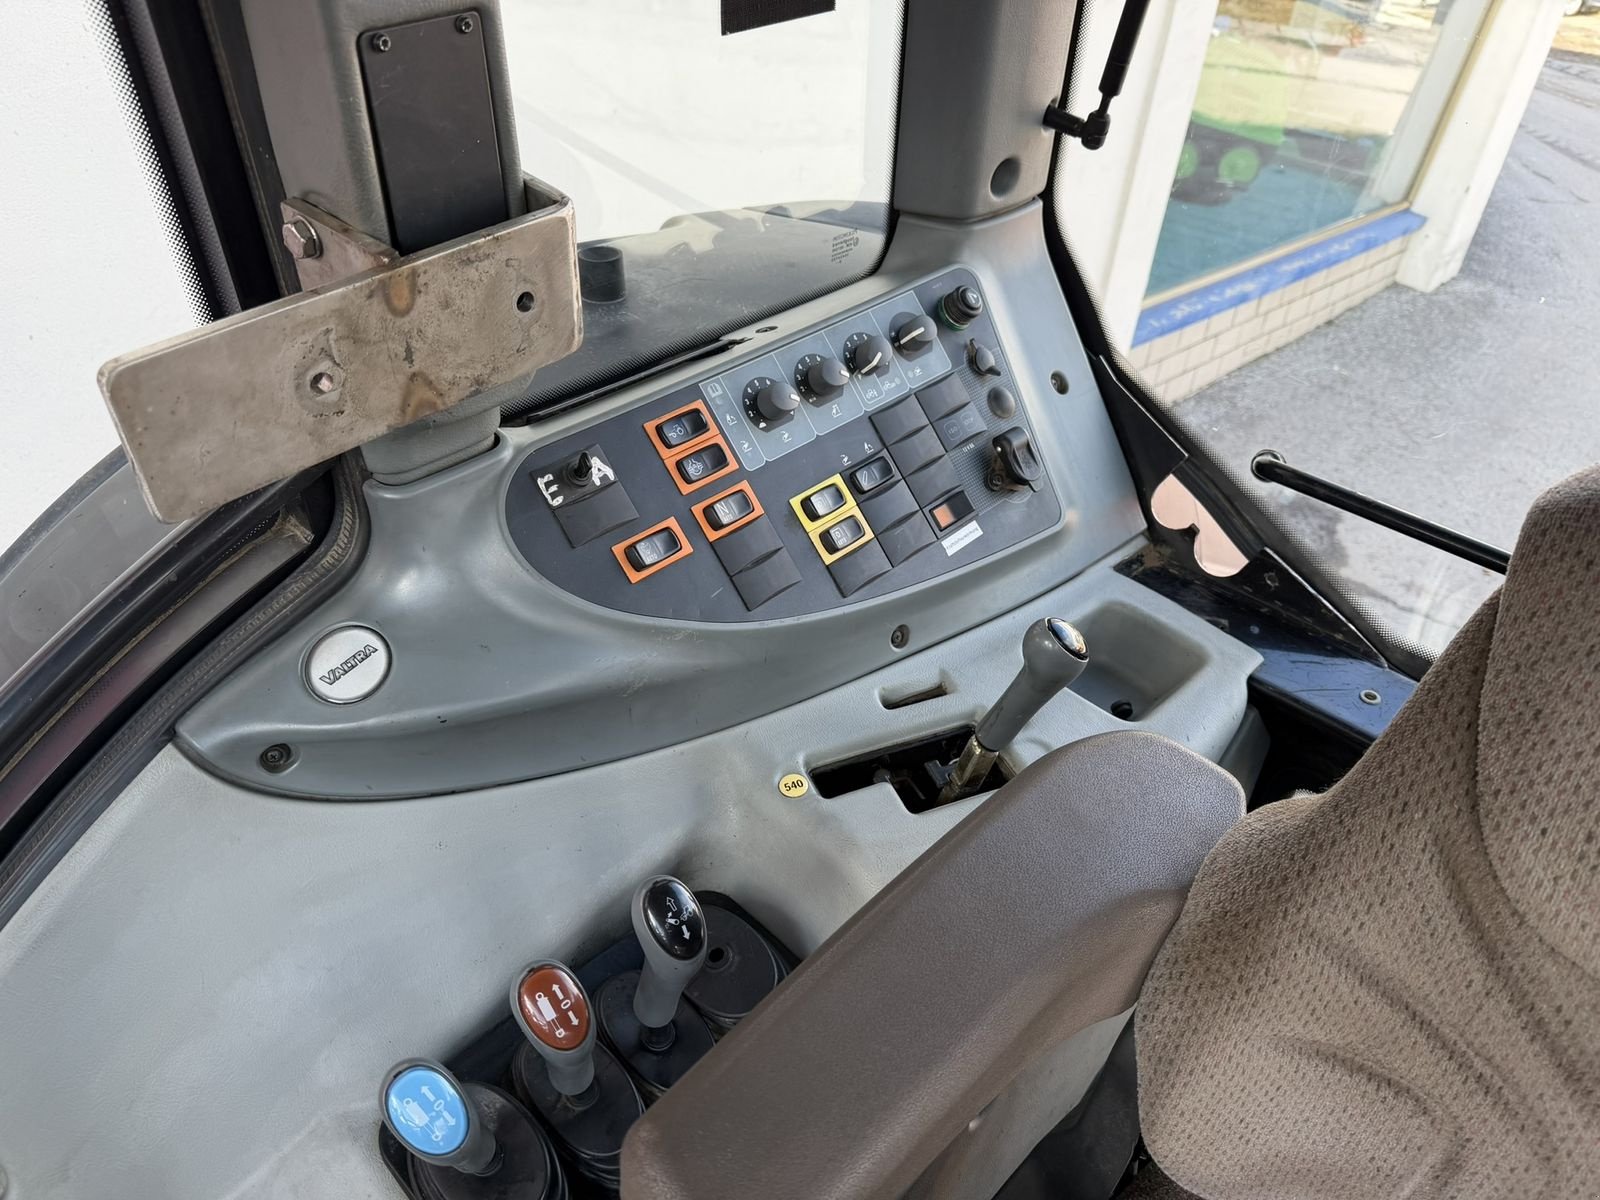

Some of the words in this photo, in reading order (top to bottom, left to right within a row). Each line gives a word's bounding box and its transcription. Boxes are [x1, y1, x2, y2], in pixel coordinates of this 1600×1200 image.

[537, 473, 564, 506] E
[591, 456, 615, 486] A
[716, 501, 729, 515] N
[319, 644, 378, 686] VALTRA
[784, 779, 804, 792] 540
